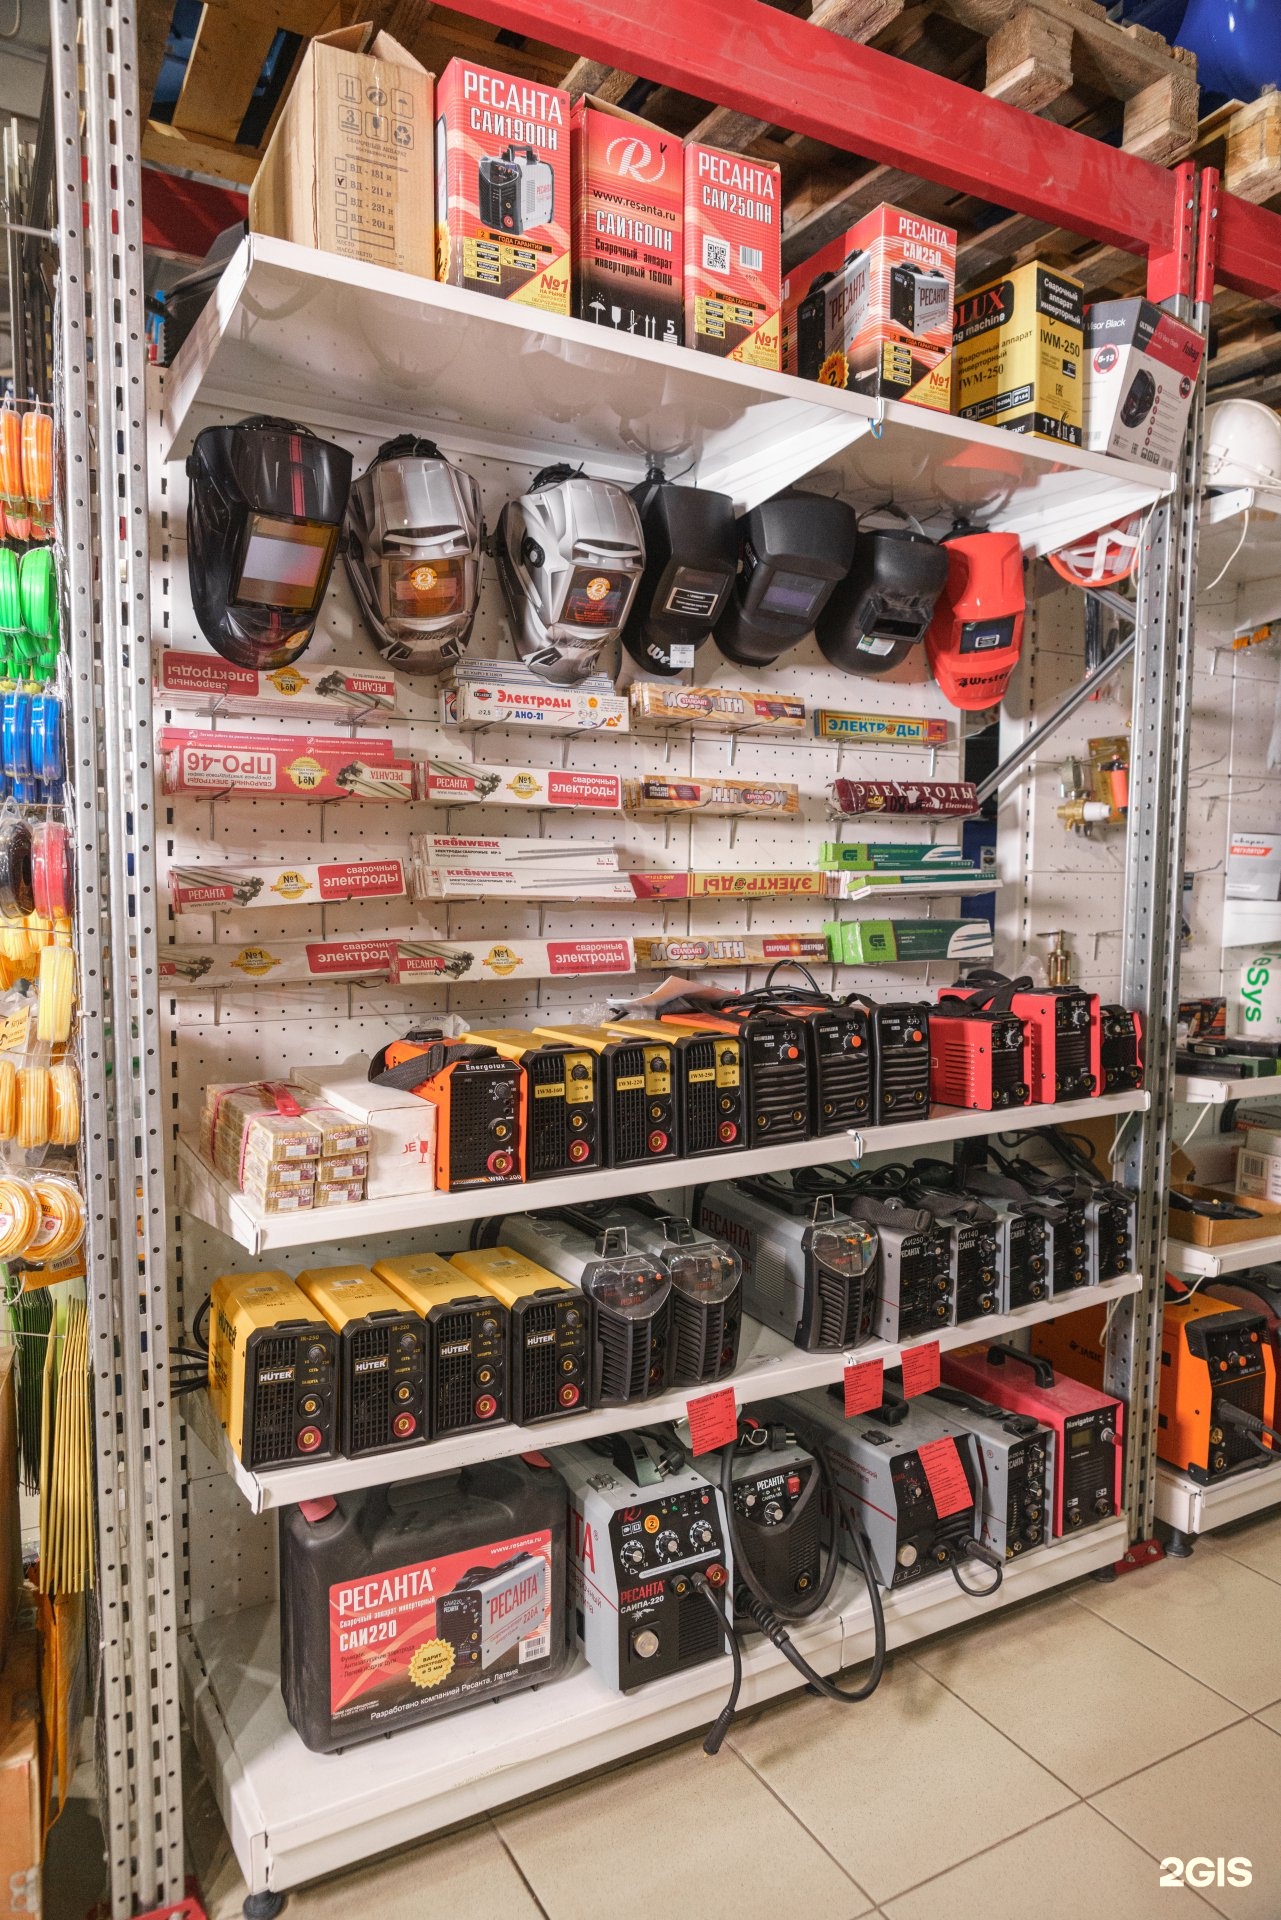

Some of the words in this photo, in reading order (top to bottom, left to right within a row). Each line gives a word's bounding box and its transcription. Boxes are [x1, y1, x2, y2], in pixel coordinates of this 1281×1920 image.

[464, 70, 563, 126] РЕСАНТА
[470, 107, 558, 151] САИ190ПН
[698, 152, 774, 199] РЕСАНТА
[593, 189, 676, 222] www.resanta.ru
[702, 185, 772, 225] САИ250ПН
[595, 210, 672, 252] САИ160ПН
[899, 216, 948, 247] РЕСАНТА
[595, 238, 638, 260] Сварочный
[643, 253, 673, 270] аппарат
[903, 240, 942, 266] САИ250
[595, 257, 646, 280] инверторный
[540, 274, 568, 293] №1
[1044, 277, 1078, 301] Сварочный
[831, 270, 866, 330] РЕСАНТА
[919, 286, 947, 307] РЕСАНТА
[1048, 292, 1074, 310] аппарат
[1040, 301, 1081, 324] инверторный
[966, 312, 1006, 336] machine
[1106, 318, 1126, 329] Black
[958, 342, 999, 365] Сварочный
[1001, 330, 1033, 348] аппарат
[1040, 328, 1080, 358] IWM-250
[958, 350, 1007, 375] инверторный
[958, 363, 1004, 390] IWM-250
[168, 665, 254, 684] электроды
[352, 679, 387, 694] РЕСАНТА
[497, 690, 572, 709] Электроды
[515, 711, 544, 721] АНО-21
[187, 752, 271, 774] ПРО-46
[370, 771, 404, 781] РЕСАНТА
[436, 777, 468, 789] РЕСАНТА
[572, 776, 616, 785] сварочные
[551, 783, 616, 797] электроды
[346, 863, 398, 874] сварочные
[323, 872, 399, 887] электроды
[188, 888, 226, 900] РЕСАНТА
[318, 949, 390, 963] электрод
[575, 942, 623, 951] сварочные
[407, 959, 439, 969] РЕСАНТА
[556, 950, 625, 964] электроды
[465, 1063, 506, 1071] Energolux
[537, 1087, 563, 1095] IWM-160
[702, 1207, 751, 1248] РЕСАНТА
[958, 1229, 979, 1240] АИ140
[958, 1240, 976, 1250] ЕСАНТА
[441, 1342, 470, 1356] HÜTER
[527, 1333, 555, 1346] HÜTER
[355, 1359, 387, 1372] HÜTER
[259, 1369, 292, 1382] HÜTER
[1066, 1415, 1095, 1429] Navigator
[756, 1474, 785, 1491] РЕСАНТА
[490, 1536, 542, 1555] www.resanta.ru
[339, 1569, 434, 1616] РЕСАНТА
[489, 1574, 538, 1624] РЕСАНТА
[620, 1580, 665, 1604] РЕСАНТА
[620, 1595, 665, 1614] САИПА-220
[339, 1614, 372, 1629] Сварочный
[374, 1607, 397, 1620] аппарат
[339, 1619, 397, 1652] САИ220
[422, 1652, 442, 1663] ВАРИТ
[370, 1700, 419, 1720] Разработано
[421, 1686, 460, 1708] компанией
[494, 1668, 519, 1681] Латвия
